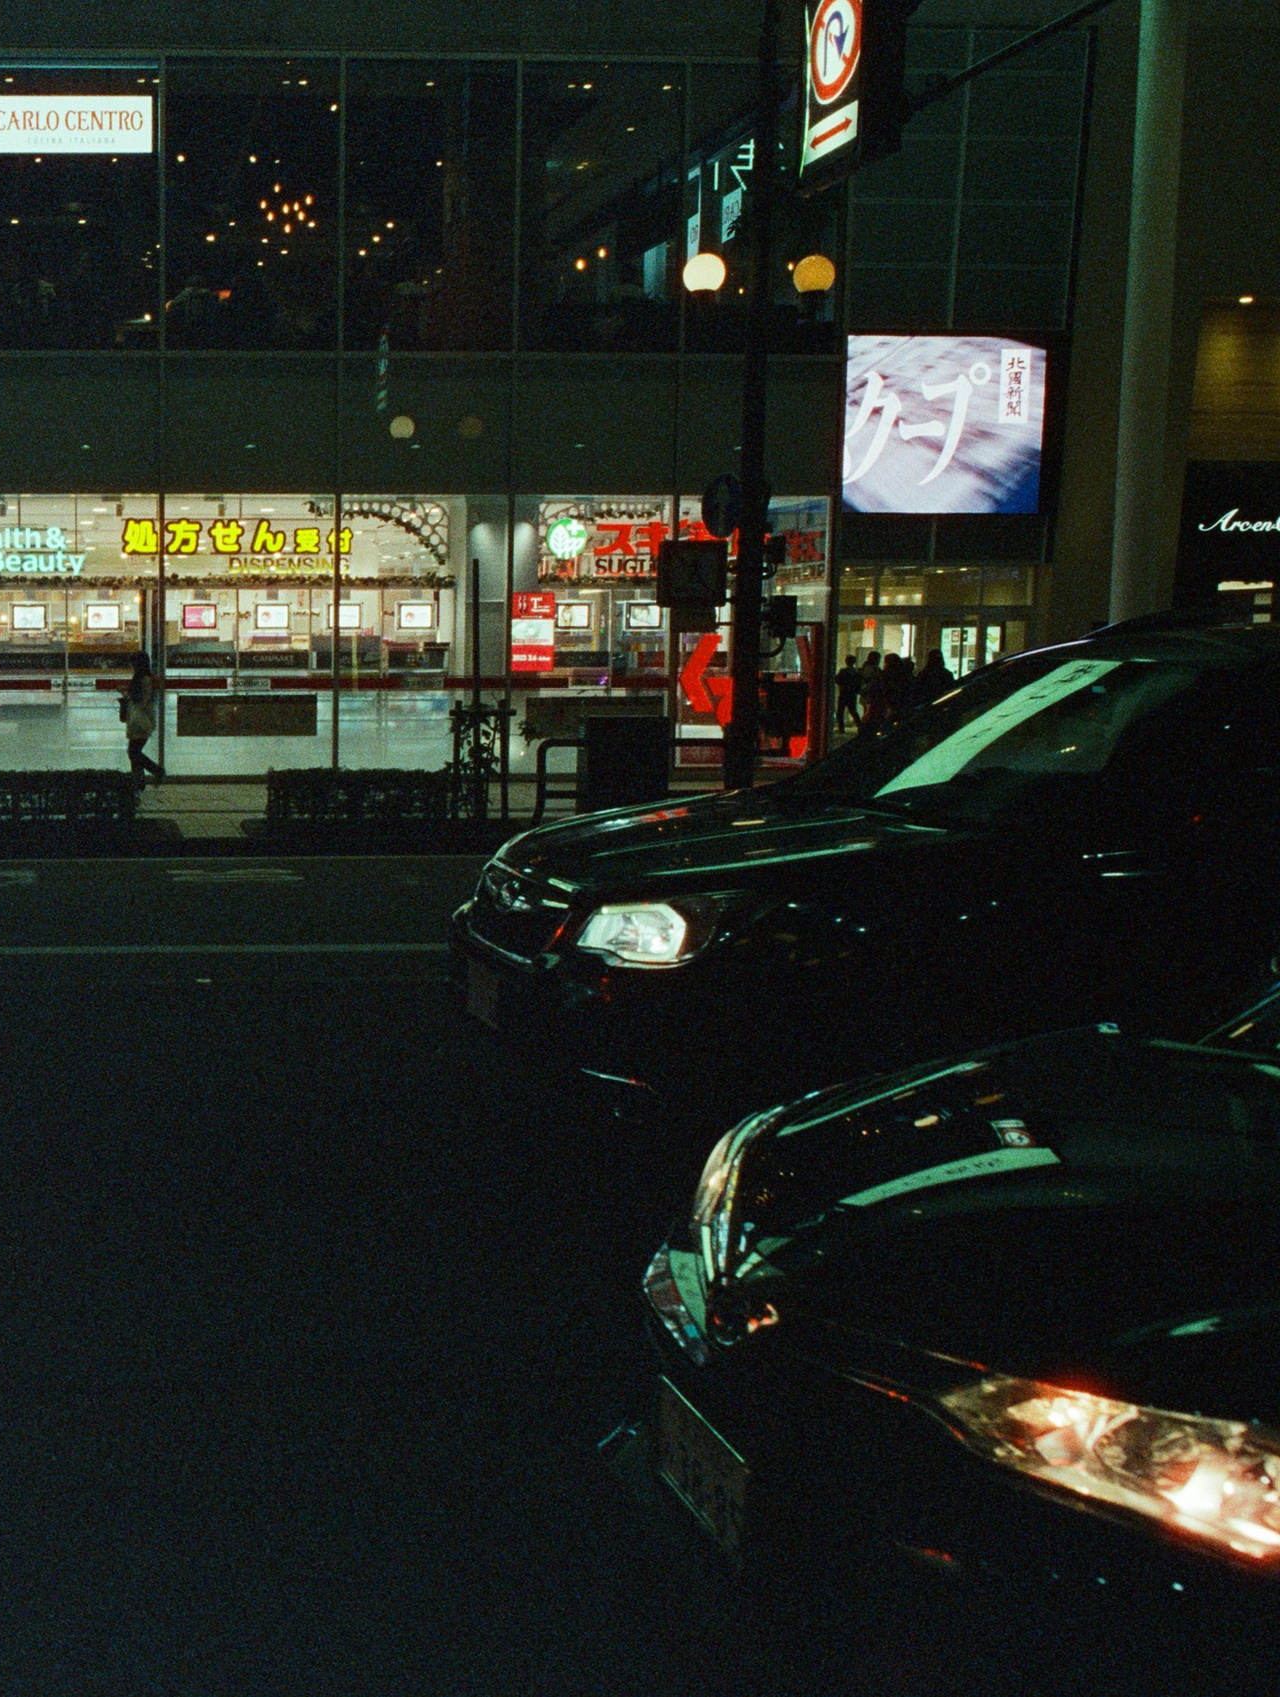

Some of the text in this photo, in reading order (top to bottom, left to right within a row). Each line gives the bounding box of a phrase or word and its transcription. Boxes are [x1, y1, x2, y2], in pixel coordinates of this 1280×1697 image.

[65, 110, 144, 132] CENTRO
[843, 361, 992, 485] クープ
[122, 518, 354, 555] 処方せん受付
[228, 556, 350, 575] DISPENSING
[594, 557, 648, 577] SUGI
